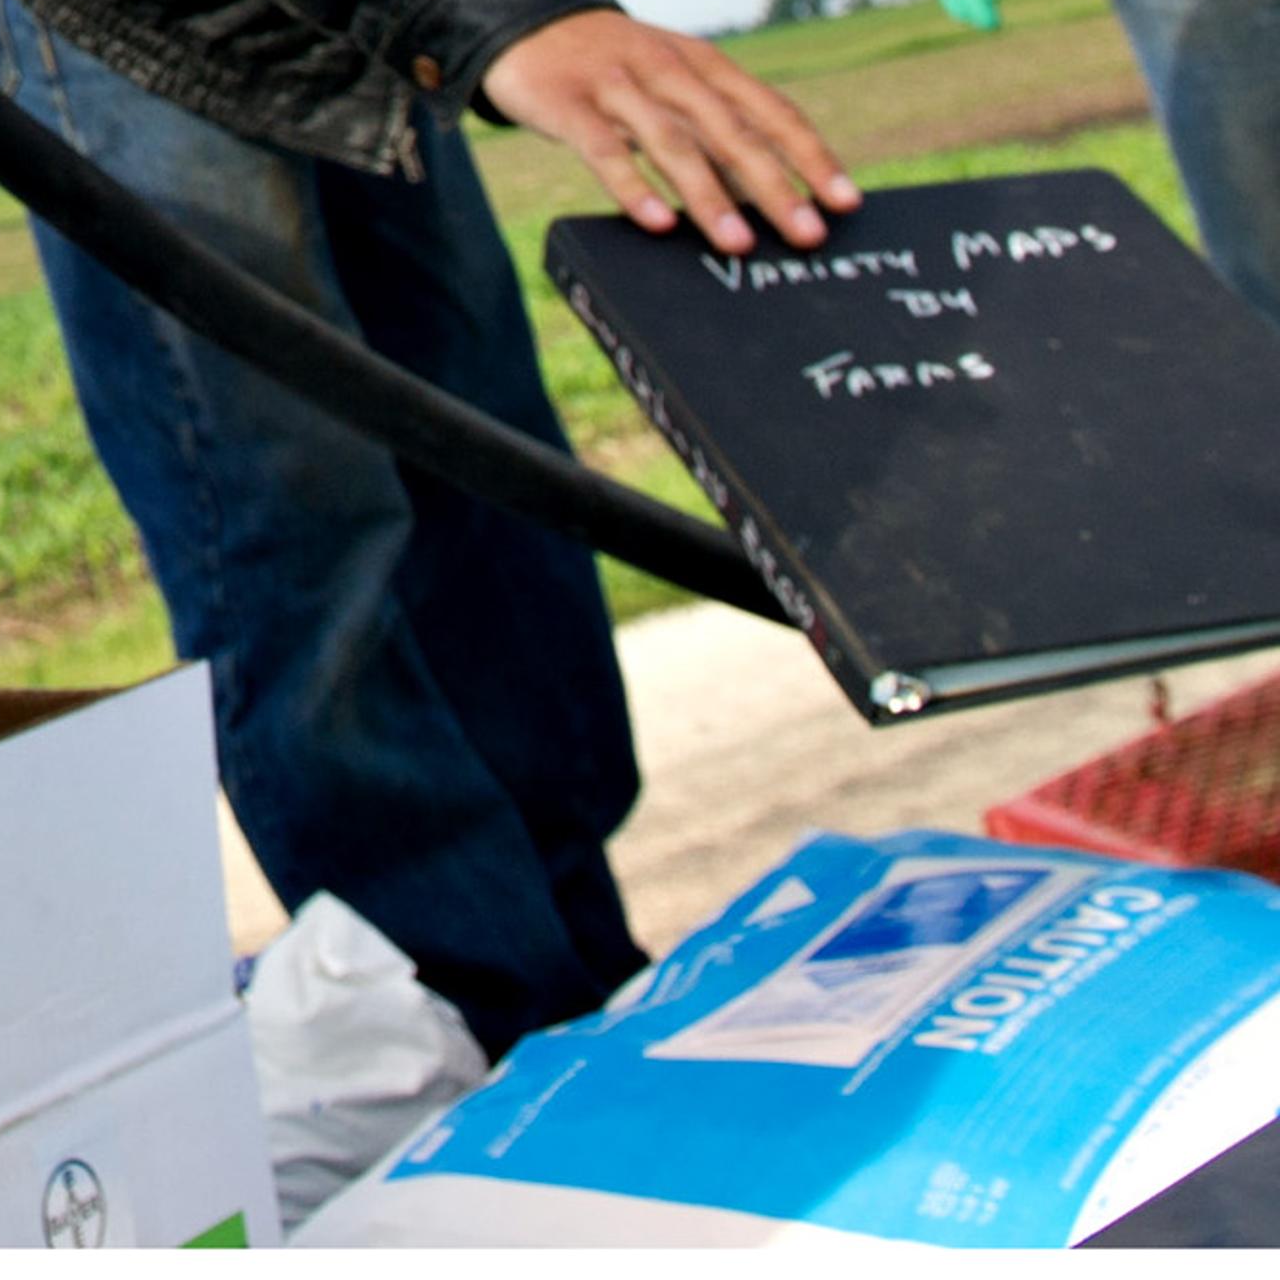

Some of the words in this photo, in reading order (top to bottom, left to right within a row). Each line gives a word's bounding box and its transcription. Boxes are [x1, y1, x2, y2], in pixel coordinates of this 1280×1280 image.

[950, 224, 1118, 271] MAPS
[801, 349, 996, 399] FARMS
[913, 885, 1164, 1052] CAUTION
